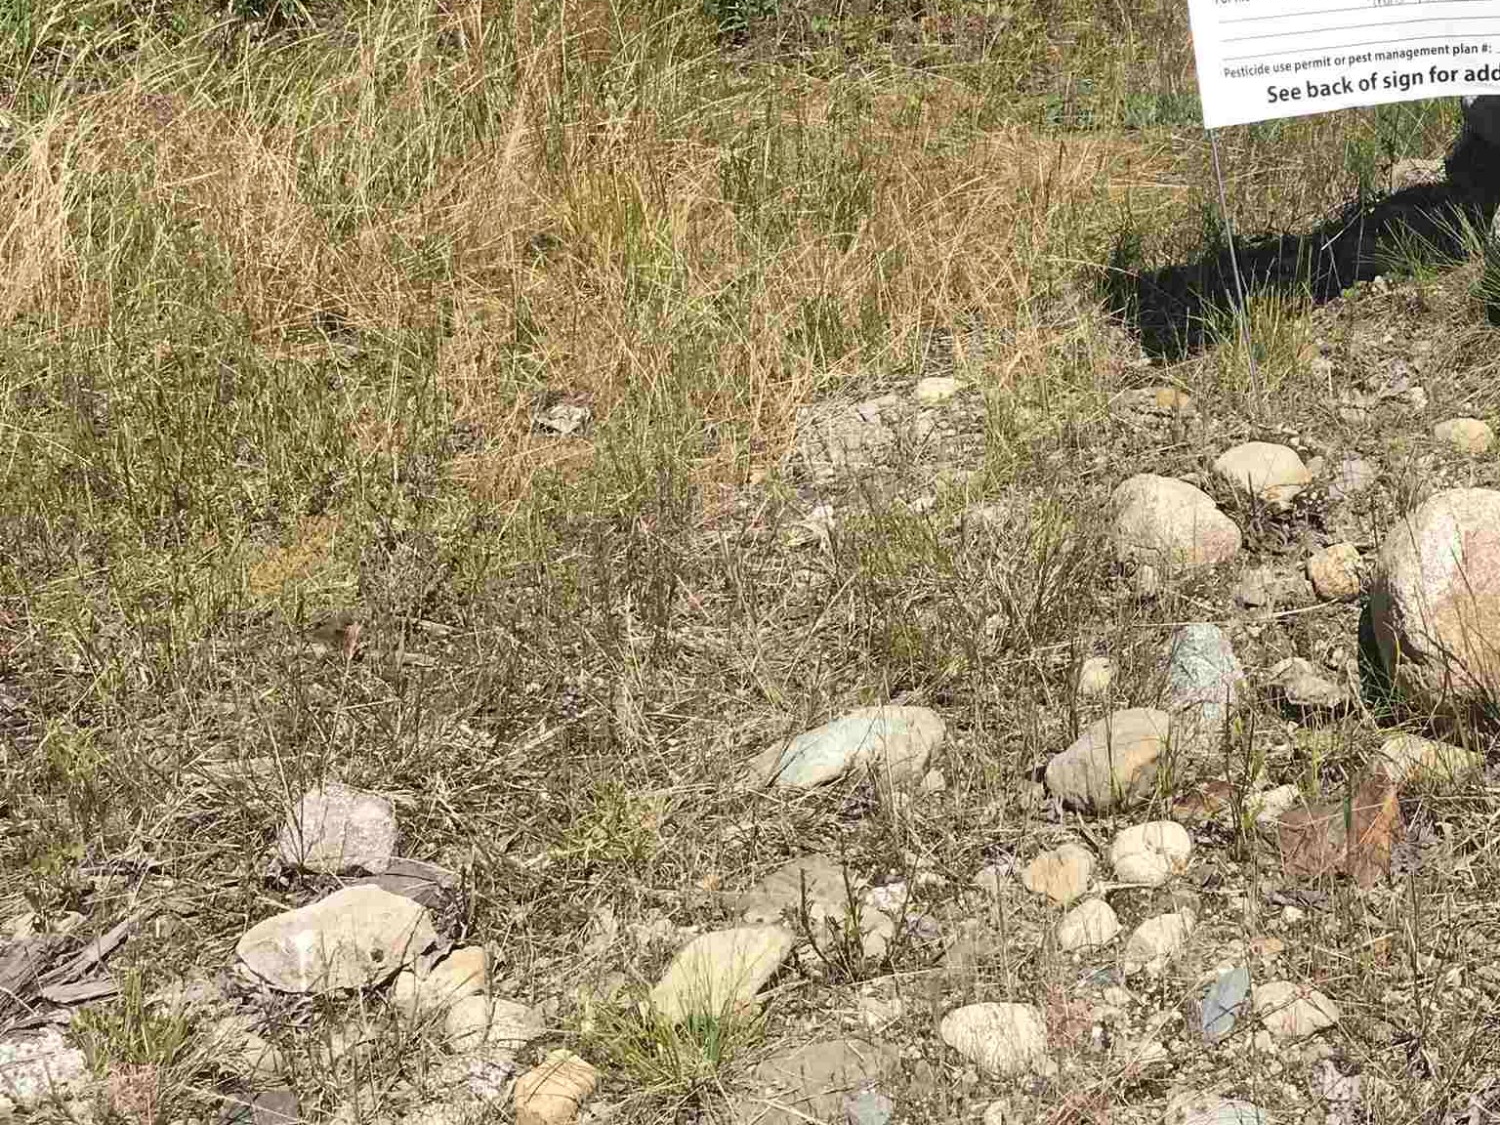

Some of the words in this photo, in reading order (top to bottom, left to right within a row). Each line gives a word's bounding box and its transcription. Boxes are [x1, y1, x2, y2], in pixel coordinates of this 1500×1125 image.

[1223, 63, 1270, 78] Pesticide
[1273, 63, 1292, 72] use
[1294, 57, 1330, 74] permit
[1334, 57, 1346, 66] or
[1349, 52, 1372, 68] pest
[1374, 44, 1450, 60] management
[1453, 44, 1478, 56] plan
[1481, 43, 1492, 54] #:
[1267, 85, 1302, 104] See
[1306, 76, 1353, 98] back
[1358, 72, 1378, 92] of
[1383, 70, 1424, 91] sign
[1429, 65, 1459, 83] for
